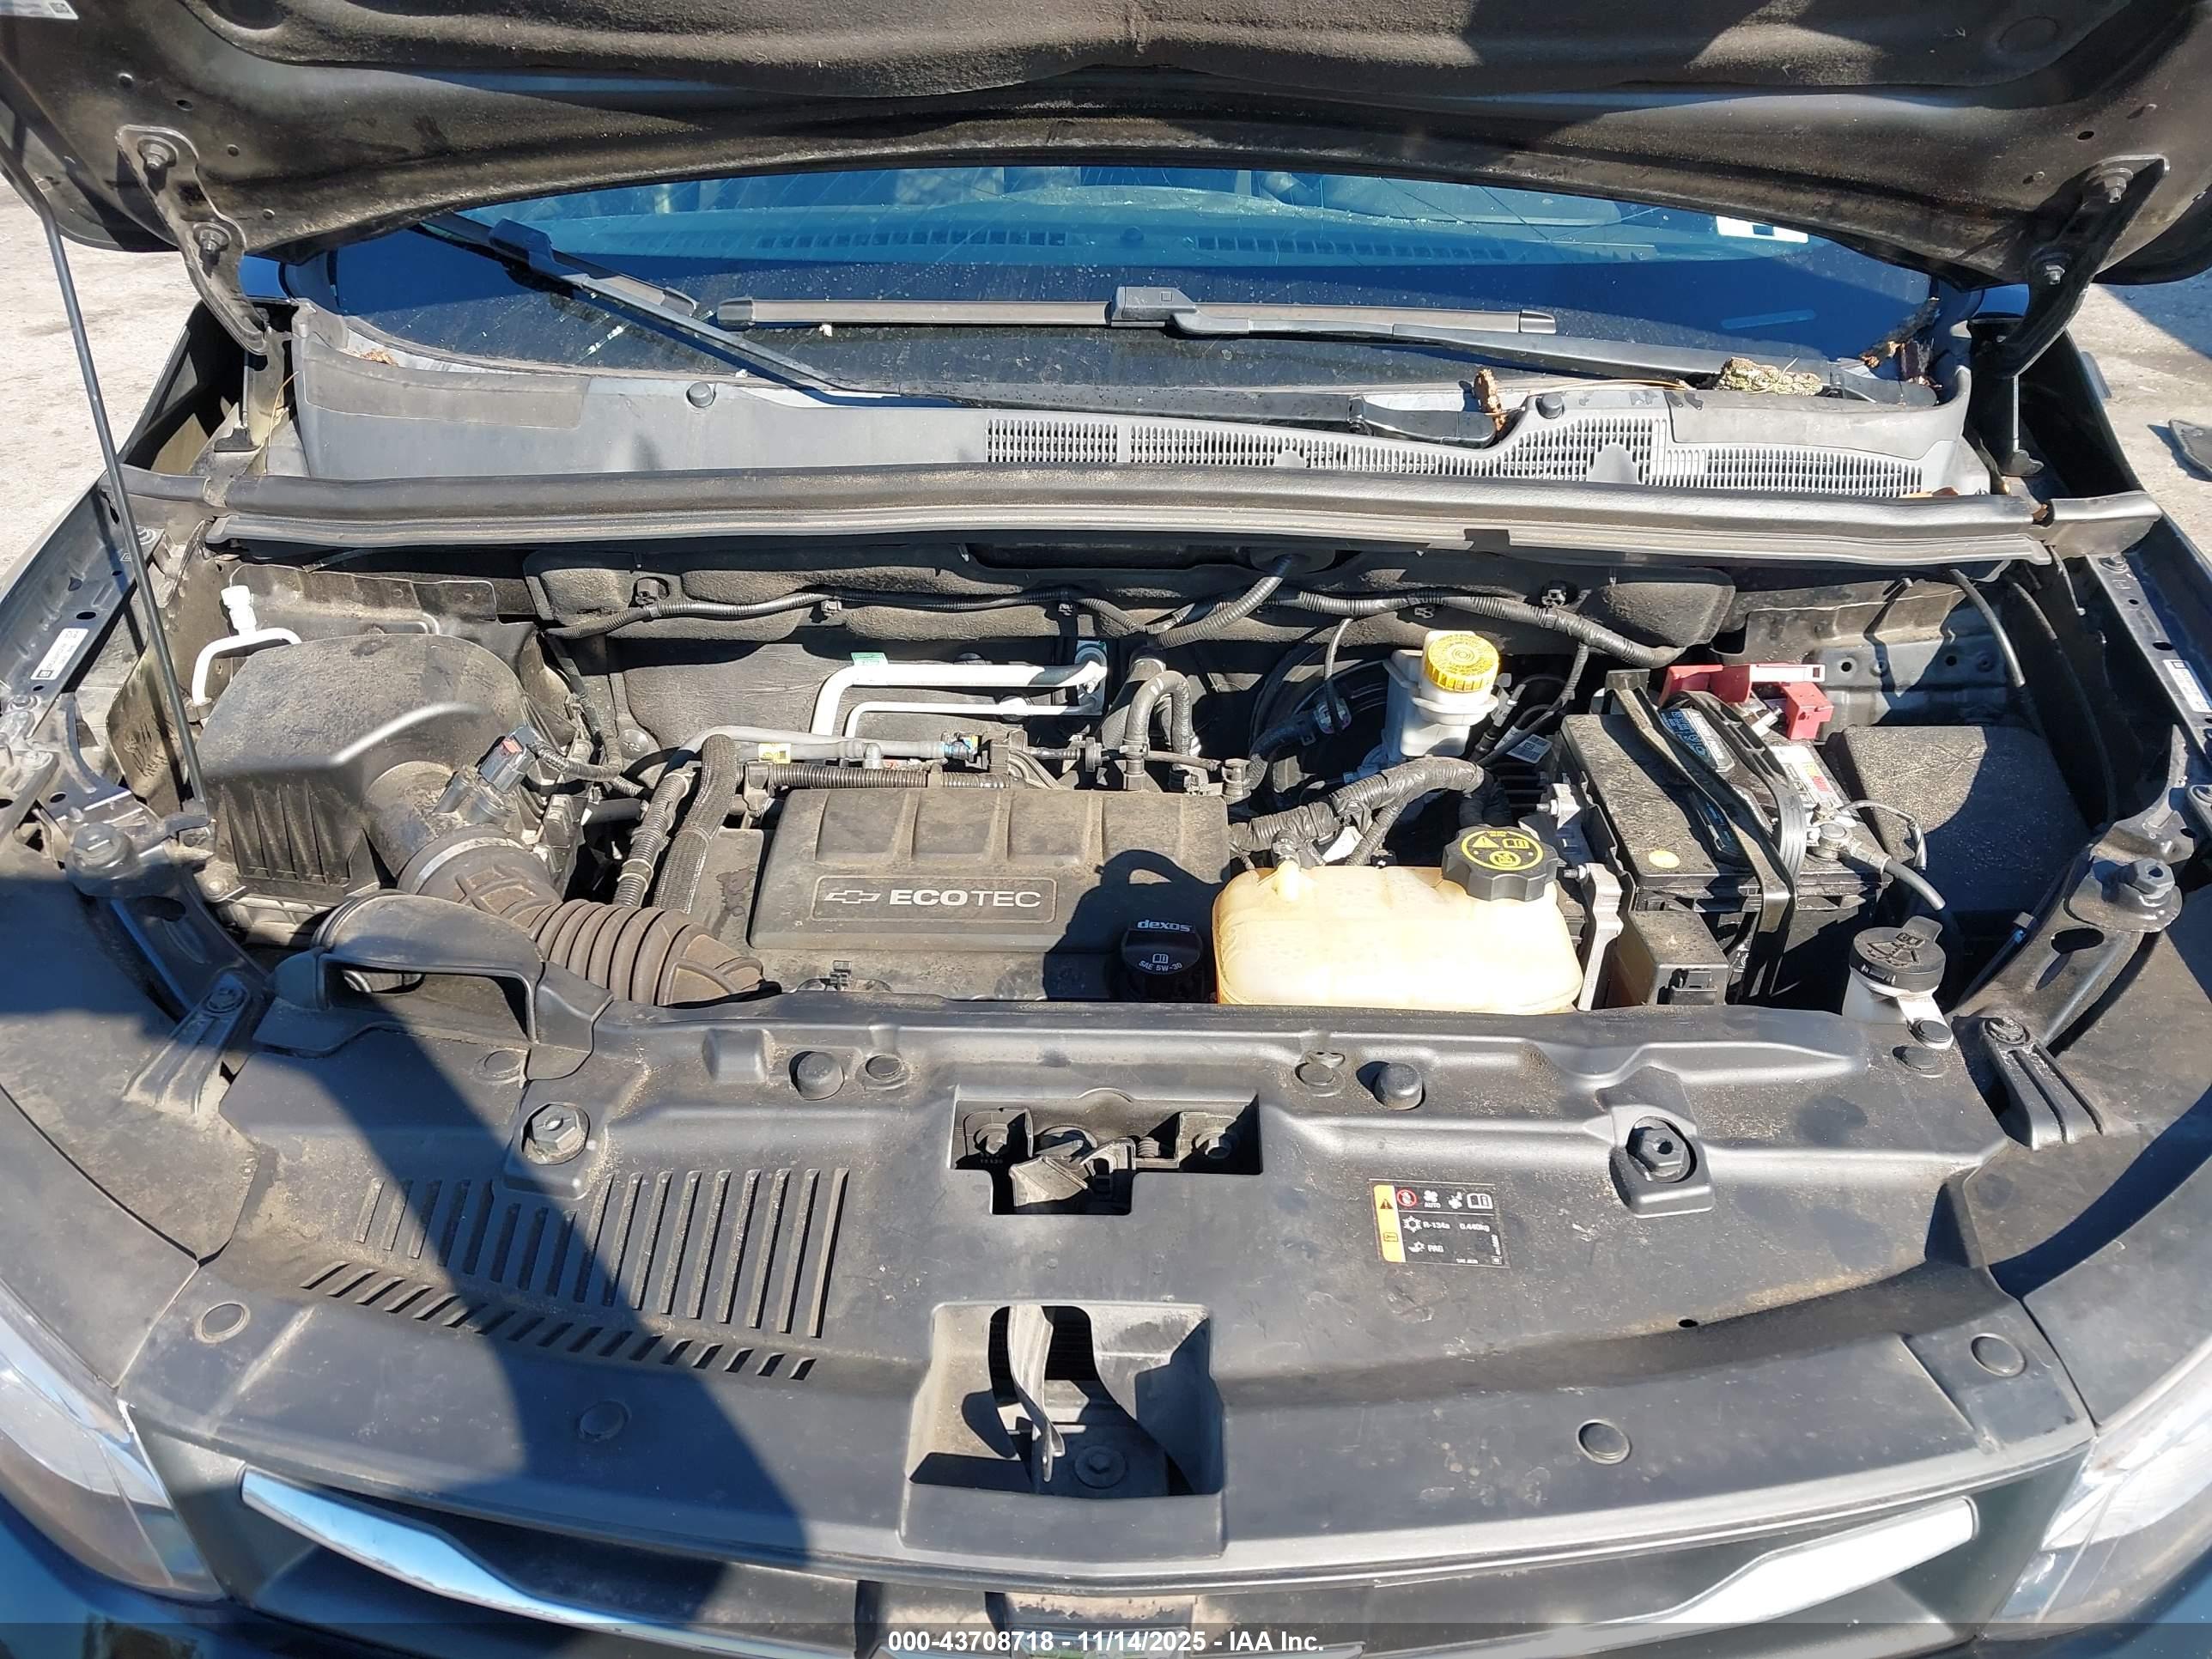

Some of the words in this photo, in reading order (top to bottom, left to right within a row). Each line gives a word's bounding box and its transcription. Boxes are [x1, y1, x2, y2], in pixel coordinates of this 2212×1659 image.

[889, 889, 1042, 908] ECOTEC
[1137, 919, 1193, 932] dexos
[1139, 960, 1154, 970] SAE
[1156, 962, 1182, 972] 5W-30
